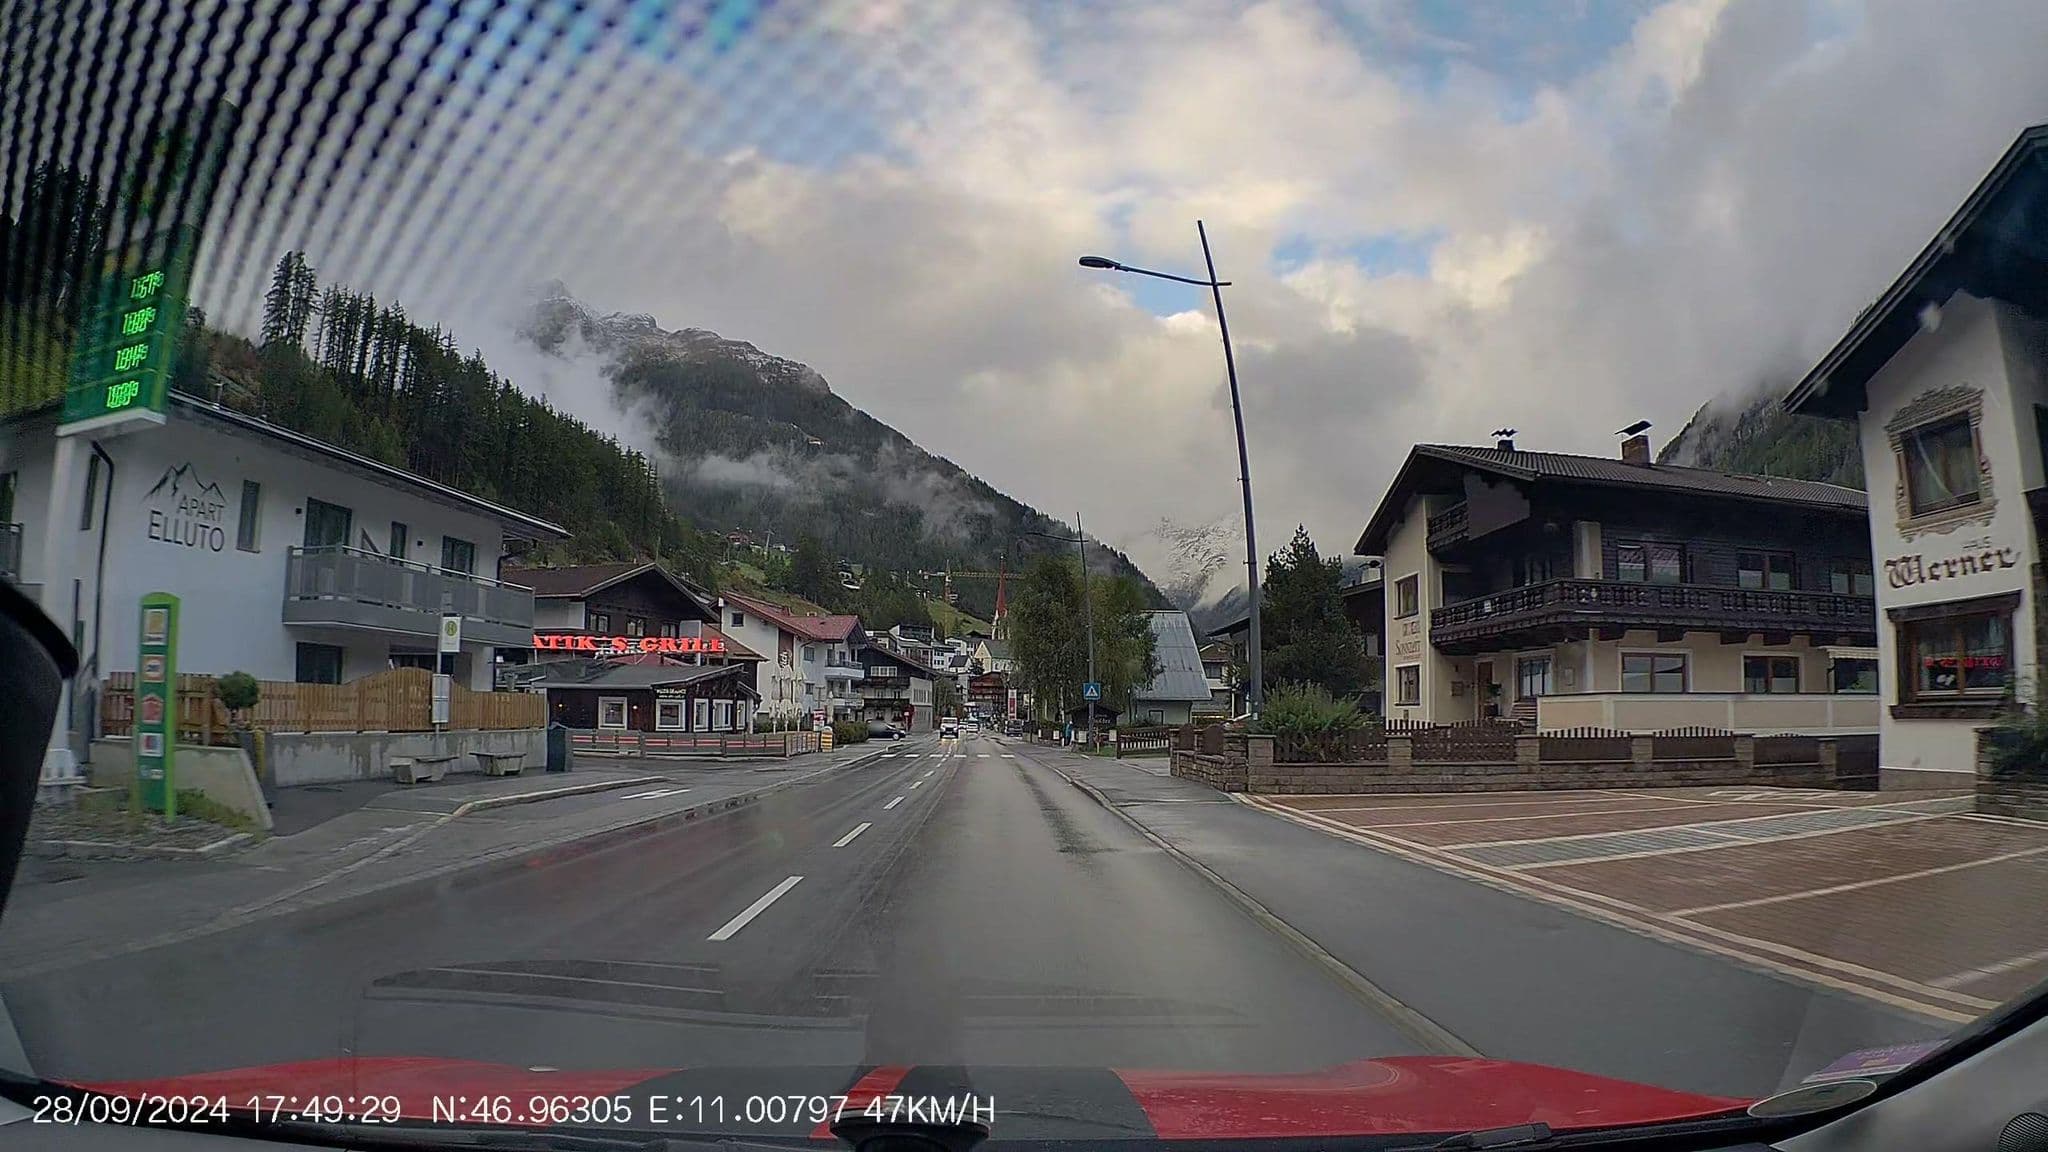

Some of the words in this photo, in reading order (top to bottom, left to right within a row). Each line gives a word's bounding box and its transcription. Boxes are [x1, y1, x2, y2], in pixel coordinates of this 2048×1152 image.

[176, 494, 224, 521] APART
[148, 509, 225, 552] ELLUTO
[1884, 547, 2022, 589] Werner
[639, 635, 728, 654] GRILL
